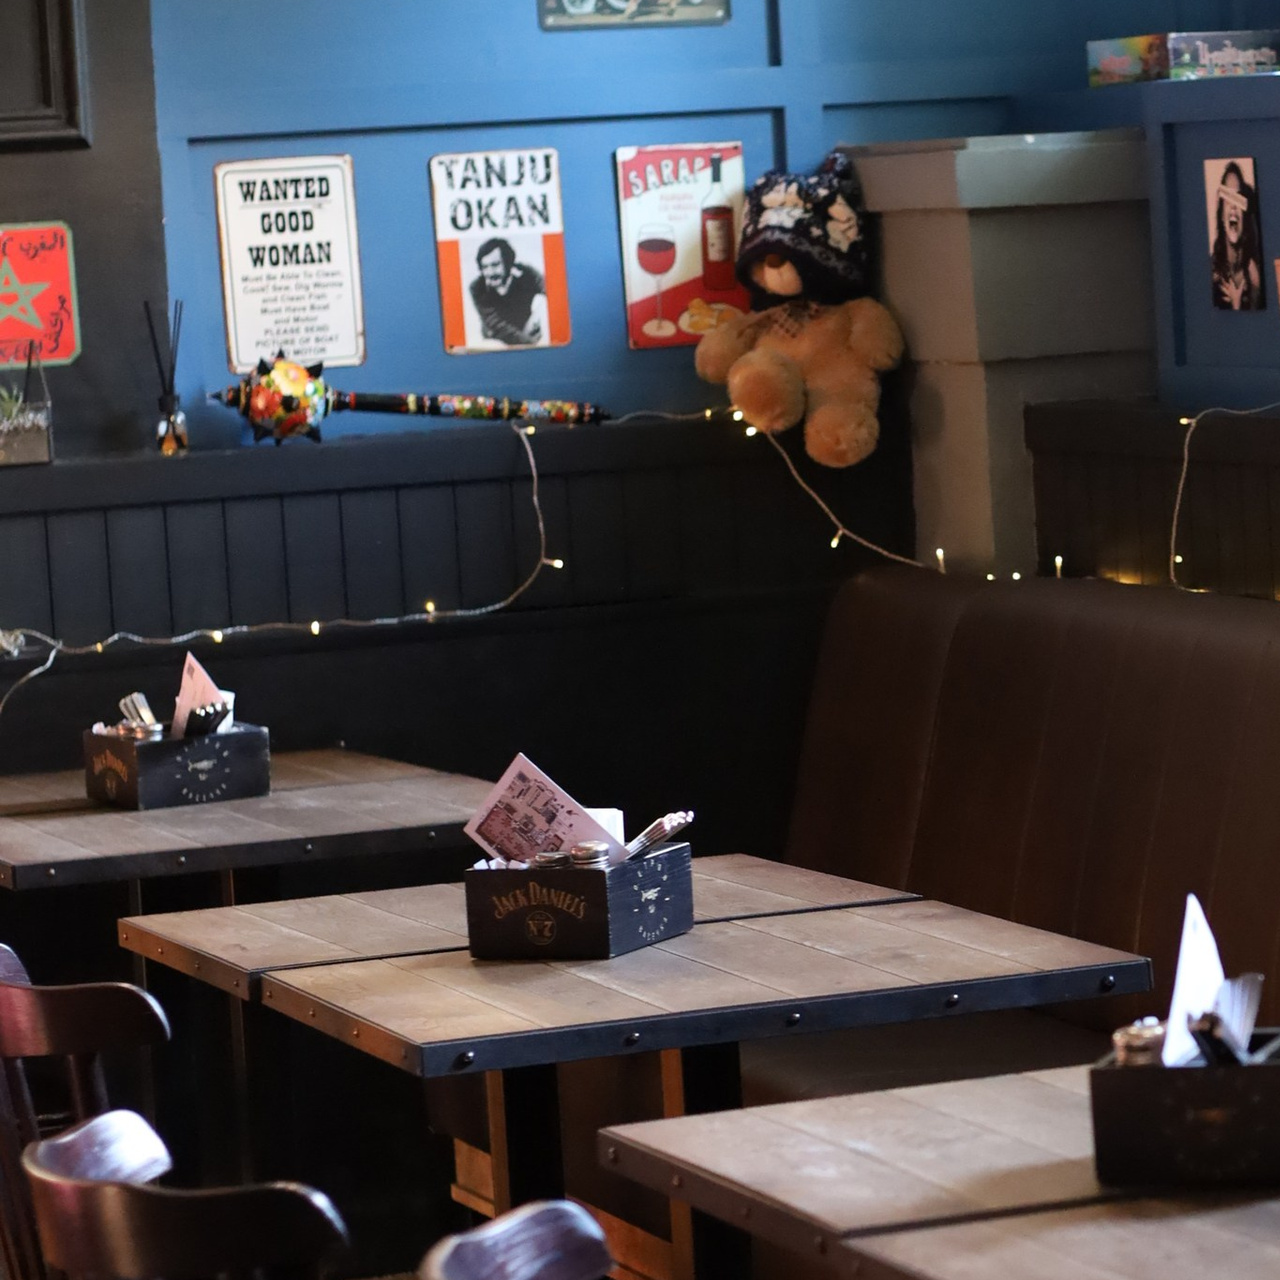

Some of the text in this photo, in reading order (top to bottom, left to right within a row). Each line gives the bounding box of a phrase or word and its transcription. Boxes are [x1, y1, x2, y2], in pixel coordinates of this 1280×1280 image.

[438, 154, 552, 189] TANJU
[238, 177, 330, 202] WANTED
[261, 210, 314, 234] GOOD
[450, 193, 550, 231] OKAN
[248, 241, 332, 268] WOMAN
[492, 889, 529, 919] JACK
